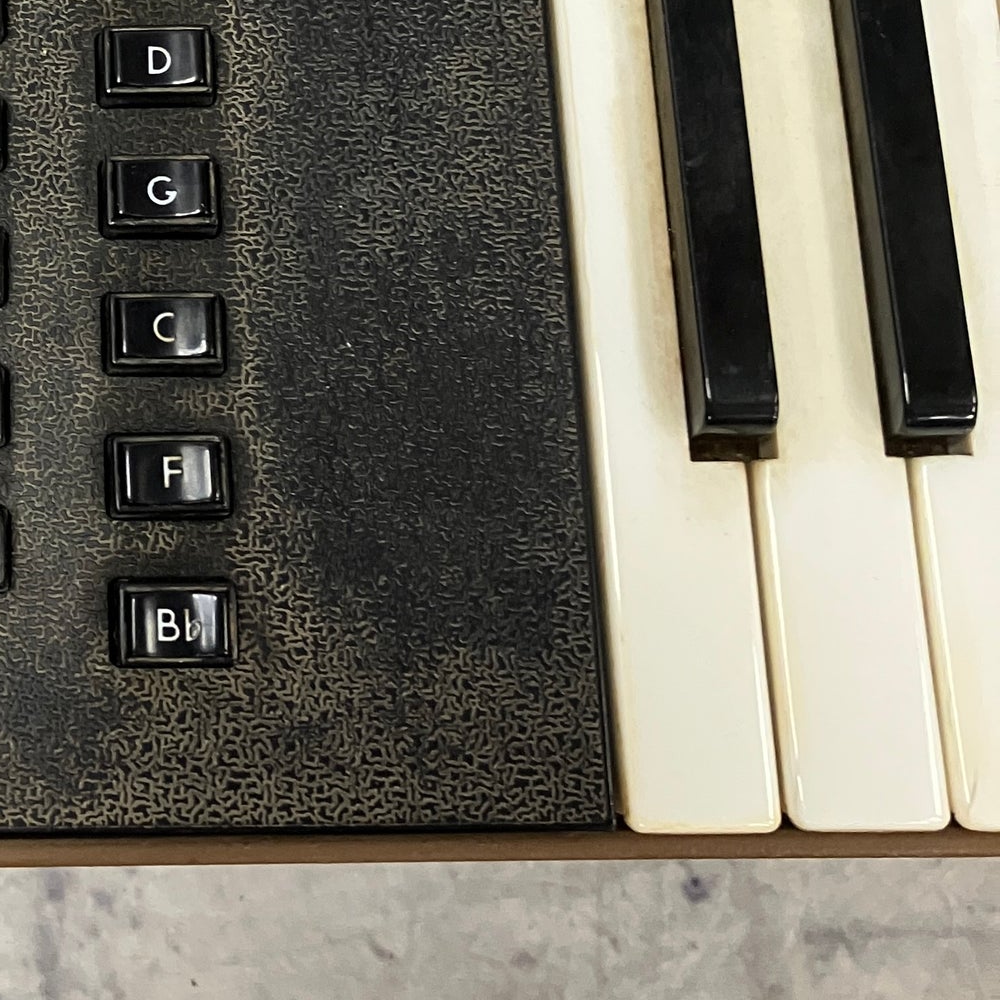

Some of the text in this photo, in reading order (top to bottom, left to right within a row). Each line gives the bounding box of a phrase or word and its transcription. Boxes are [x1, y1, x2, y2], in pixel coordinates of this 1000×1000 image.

[148, 46, 171, 74] D
[147, 176, 177, 205] G
[153, 312, 175, 342] C
[163, 456, 183, 488] F
